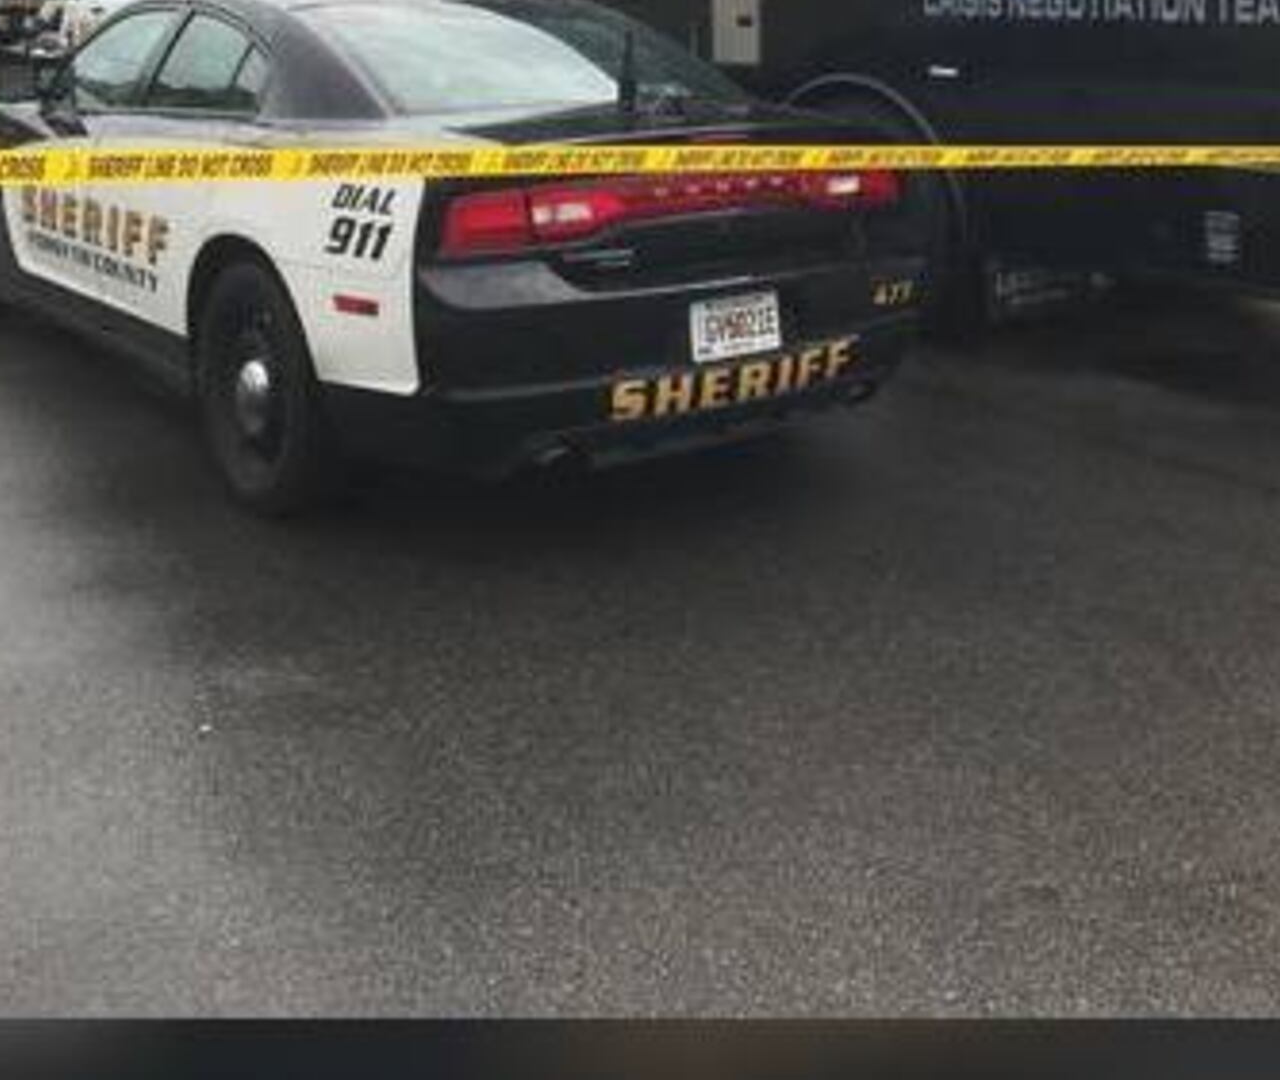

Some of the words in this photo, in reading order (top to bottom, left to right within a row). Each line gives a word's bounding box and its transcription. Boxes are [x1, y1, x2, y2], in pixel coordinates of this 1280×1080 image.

[88, 154, 145, 179] SHERIFF
[331, 184, 396, 215] DIAL
[20, 184, 169, 267] SHERIFF
[324, 217, 394, 260] 911
[93, 253, 158, 293] COUNTY
[610, 334, 860, 422] SHERIFF
